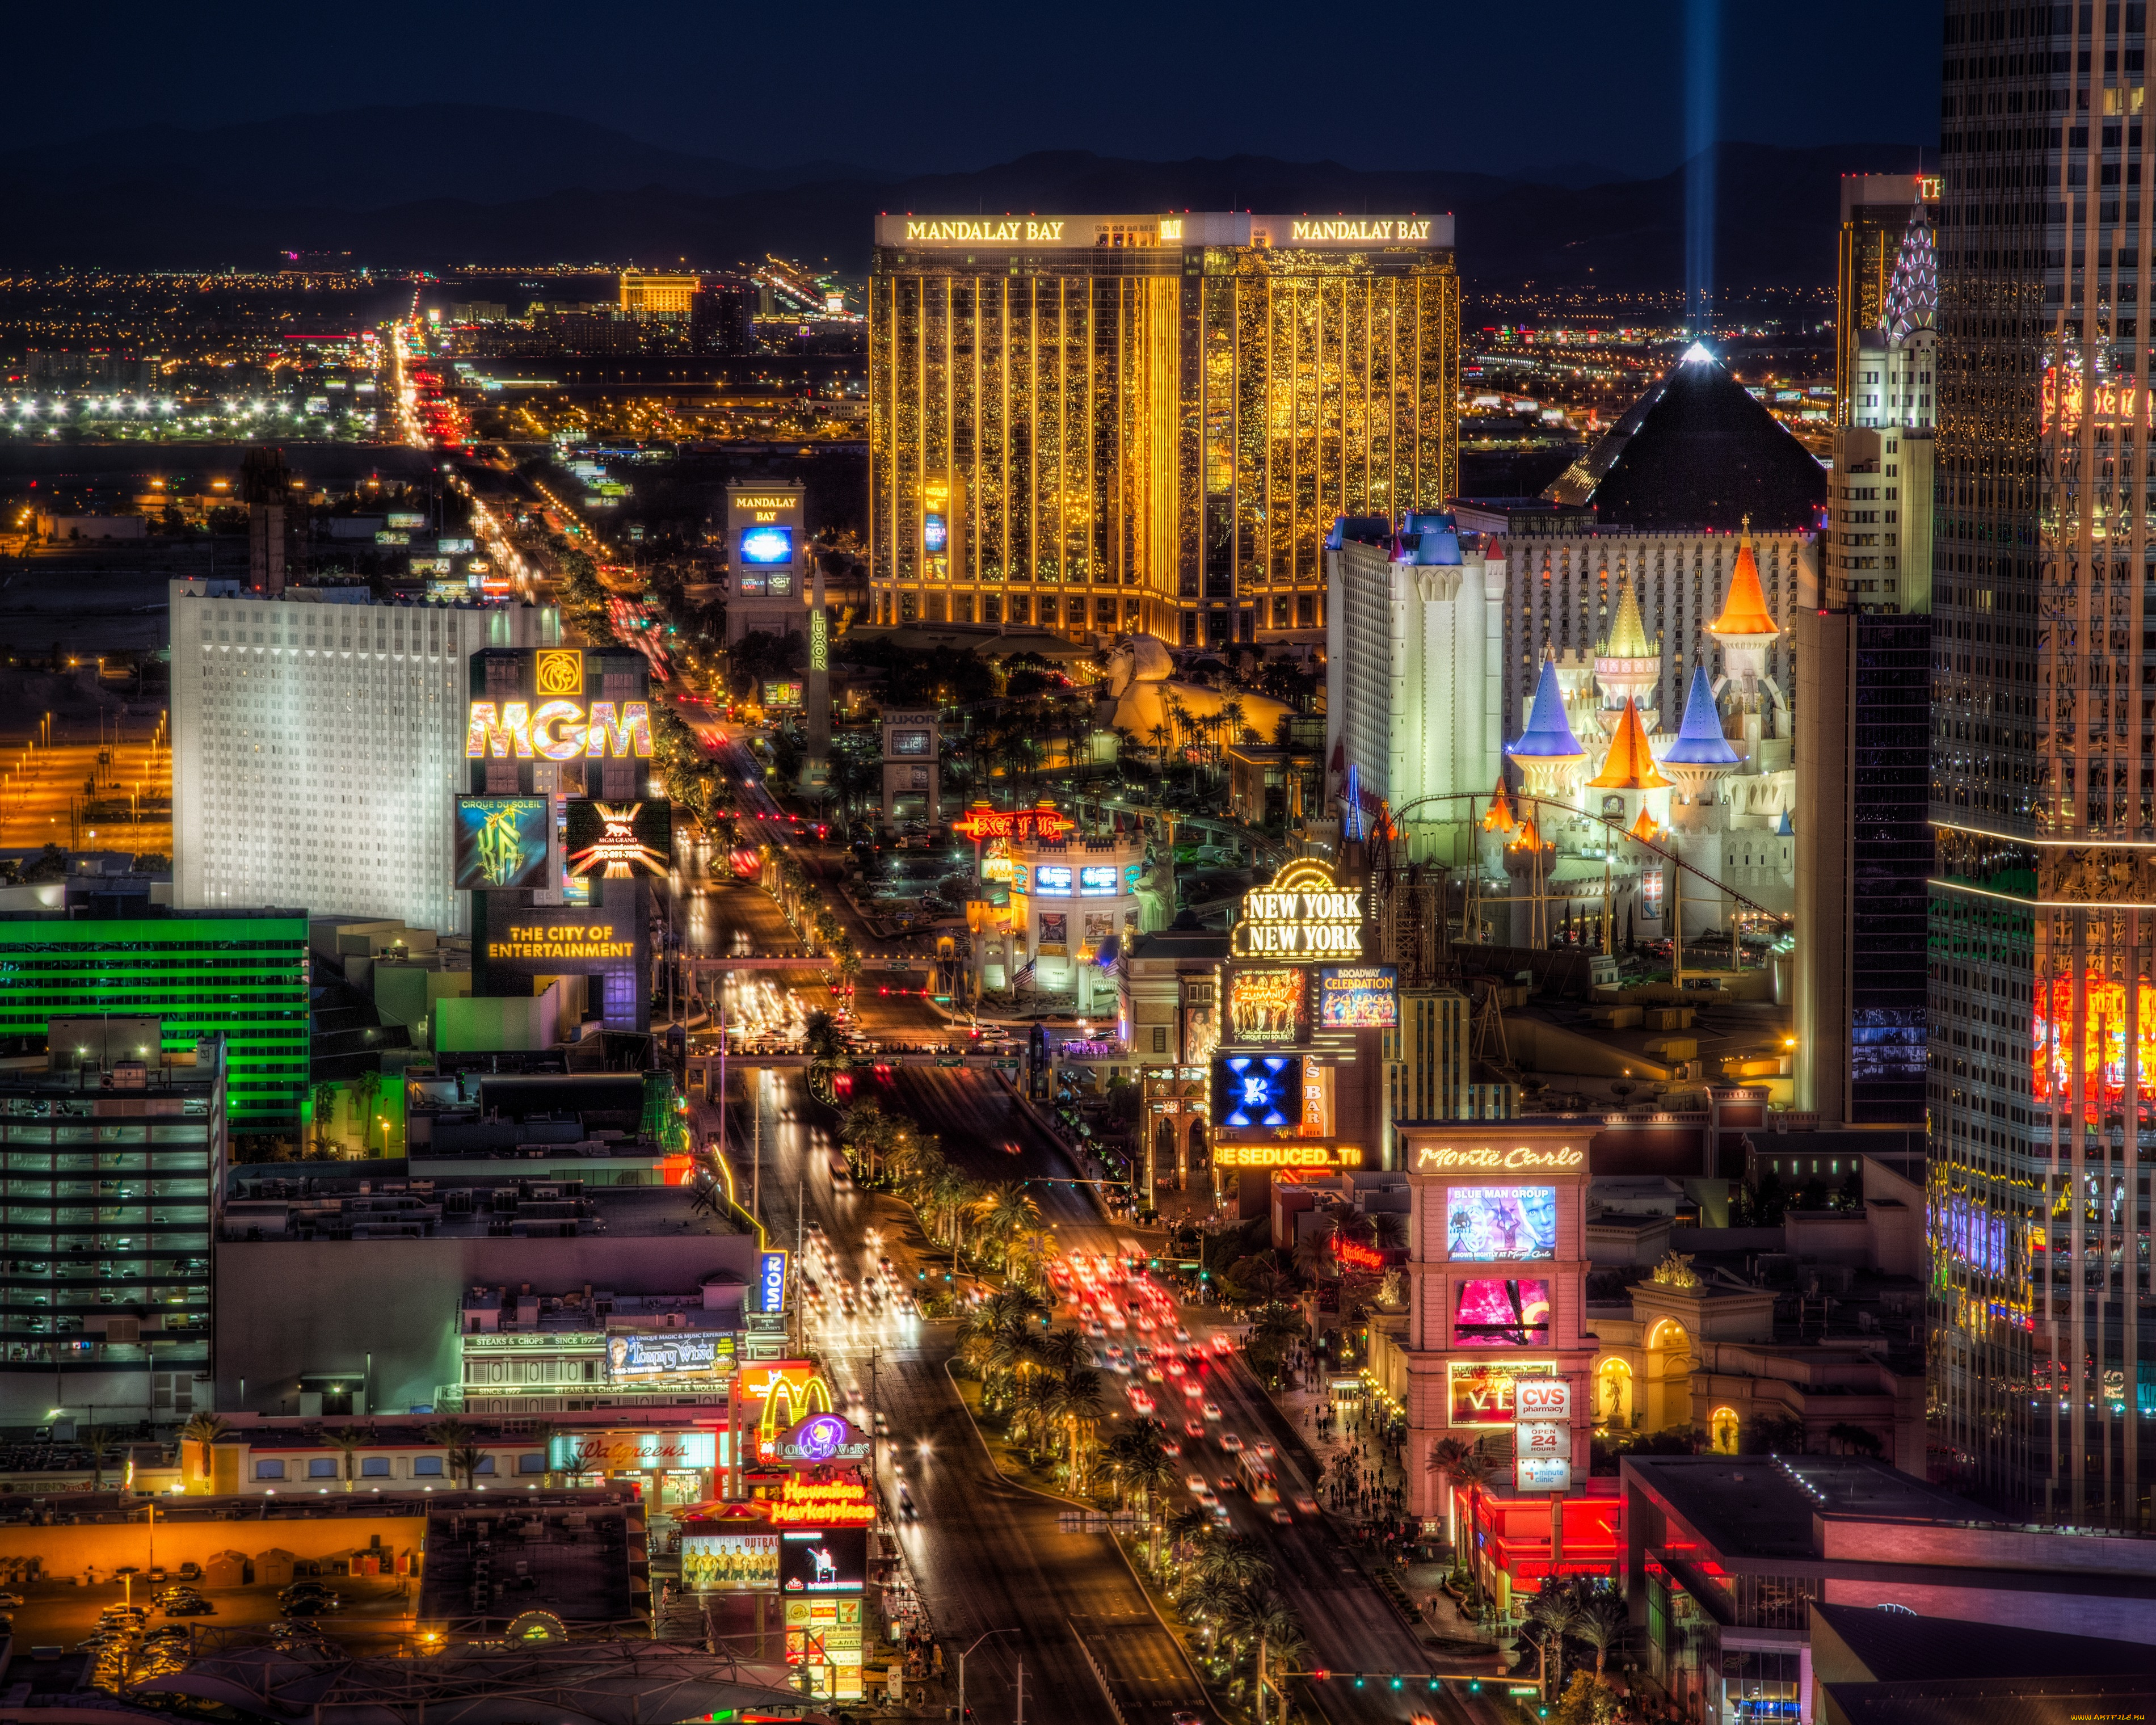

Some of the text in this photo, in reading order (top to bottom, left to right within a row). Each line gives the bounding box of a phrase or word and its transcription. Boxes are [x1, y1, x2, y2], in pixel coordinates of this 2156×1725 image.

[908, 221, 1064, 240] MANDALAY BAY
[1293, 221, 1430, 239] MANDALAY BAY
[736, 498, 795, 507] MANDALAY
[756, 512, 776, 521] BAY
[813, 611, 826, 669] LUXOR
[884, 714, 938, 725] LUXOR
[466, 700, 654, 759] MGM
[462, 801, 494, 810] CIRQUE
[1249, 892, 1361, 920] NEW YORK
[511, 926, 613, 941] THE CITY OF
[1249, 924, 1361, 952] NEW YORK
[489, 943, 634, 958] ENTERTAINMENT
[1338, 969, 1380, 978] BROADWAY
[1324, 977, 1393, 990] CELEBRATION
[1241, 988, 1291, 1000] ZUMANITY
[1304, 1086, 1321, 1124] BAR
[1215, 1147, 1236, 1164] BE
[1418, 1146, 1583, 1168] Monte Carlo
[1511, 1189, 1549, 1198] GROUP
[1523, 1389, 1564, 1405] CVS
[777, 1442, 869, 1455] POLO TOWERS
[1531, 1436, 1557, 1446] 24
[575, 1440, 689, 1463] Walgreens
[783, 1479, 865, 1501] Hawaiian
[769, 1499, 876, 1524] Marketplace
[714, 1537, 741, 1548] NIGHT
